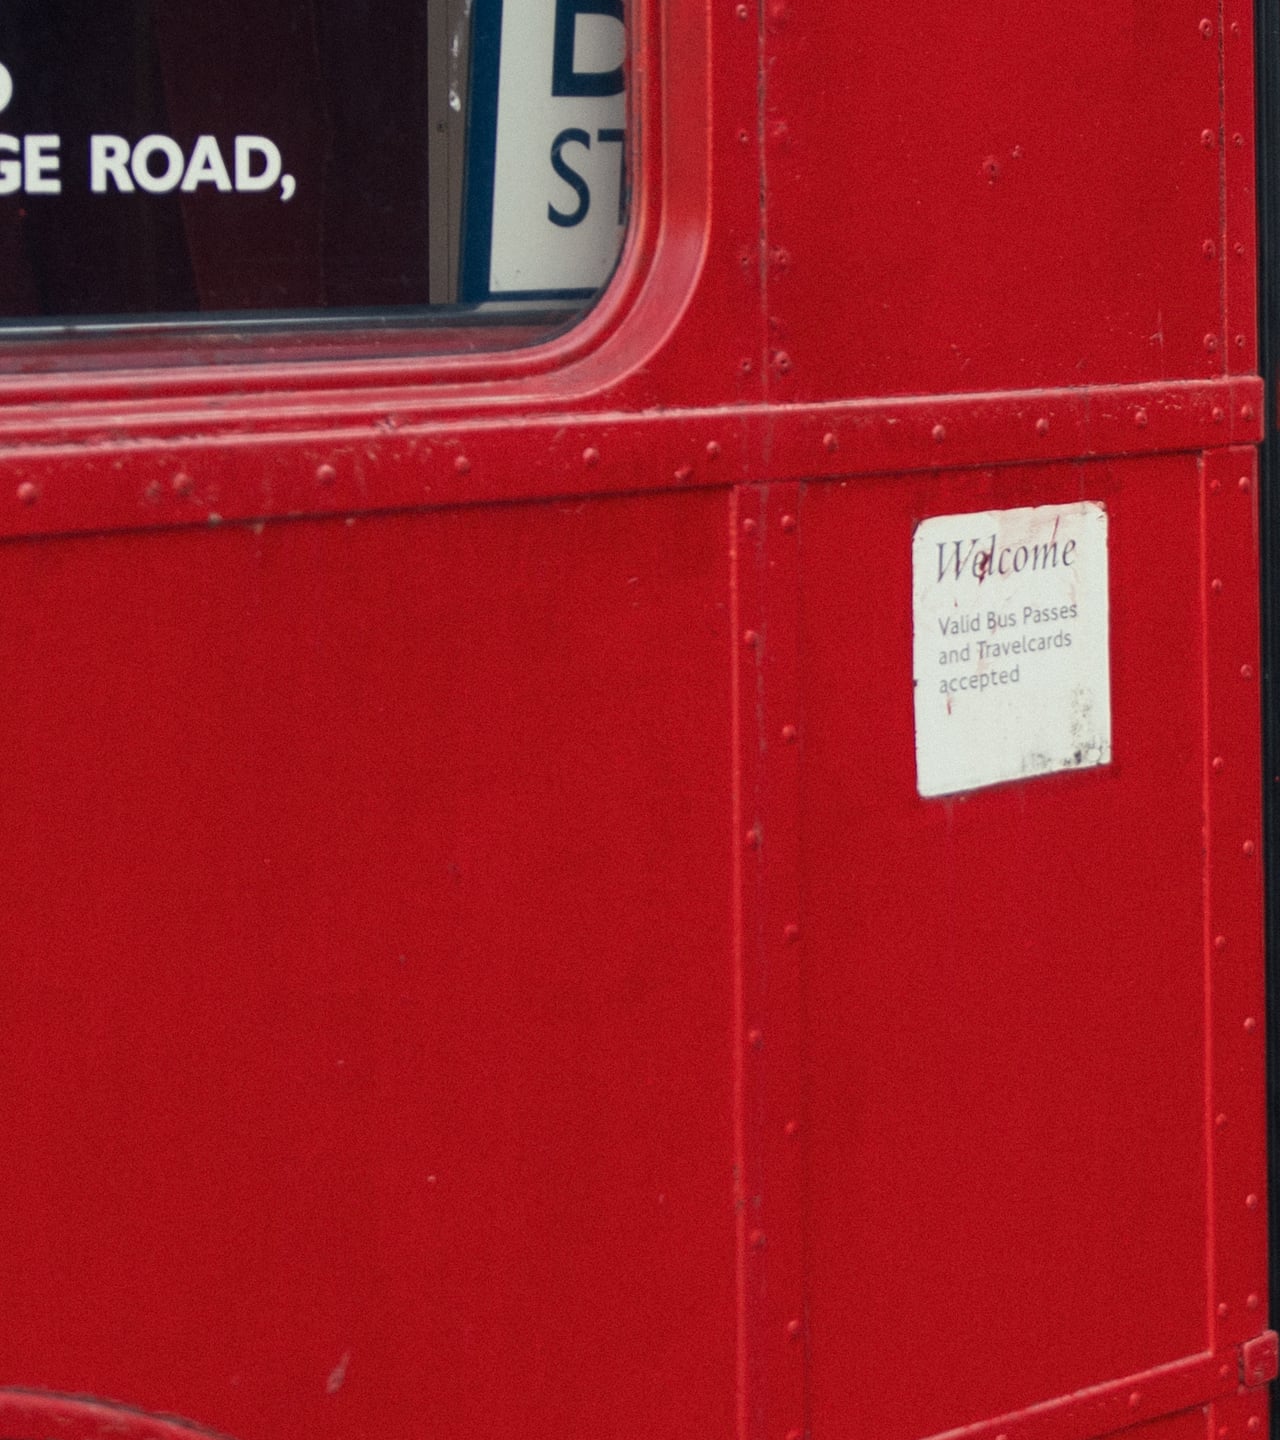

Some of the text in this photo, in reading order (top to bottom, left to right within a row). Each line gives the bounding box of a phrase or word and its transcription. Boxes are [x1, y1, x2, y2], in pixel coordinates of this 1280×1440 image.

[90, 134, 296, 201] ROAD,
[935, 534, 1077, 584] Welcome
[938, 603, 1078, 636] Valid Bus Passes
[939, 630, 1072, 665] and Travelcards
[939, 664, 1021, 694] accepted
